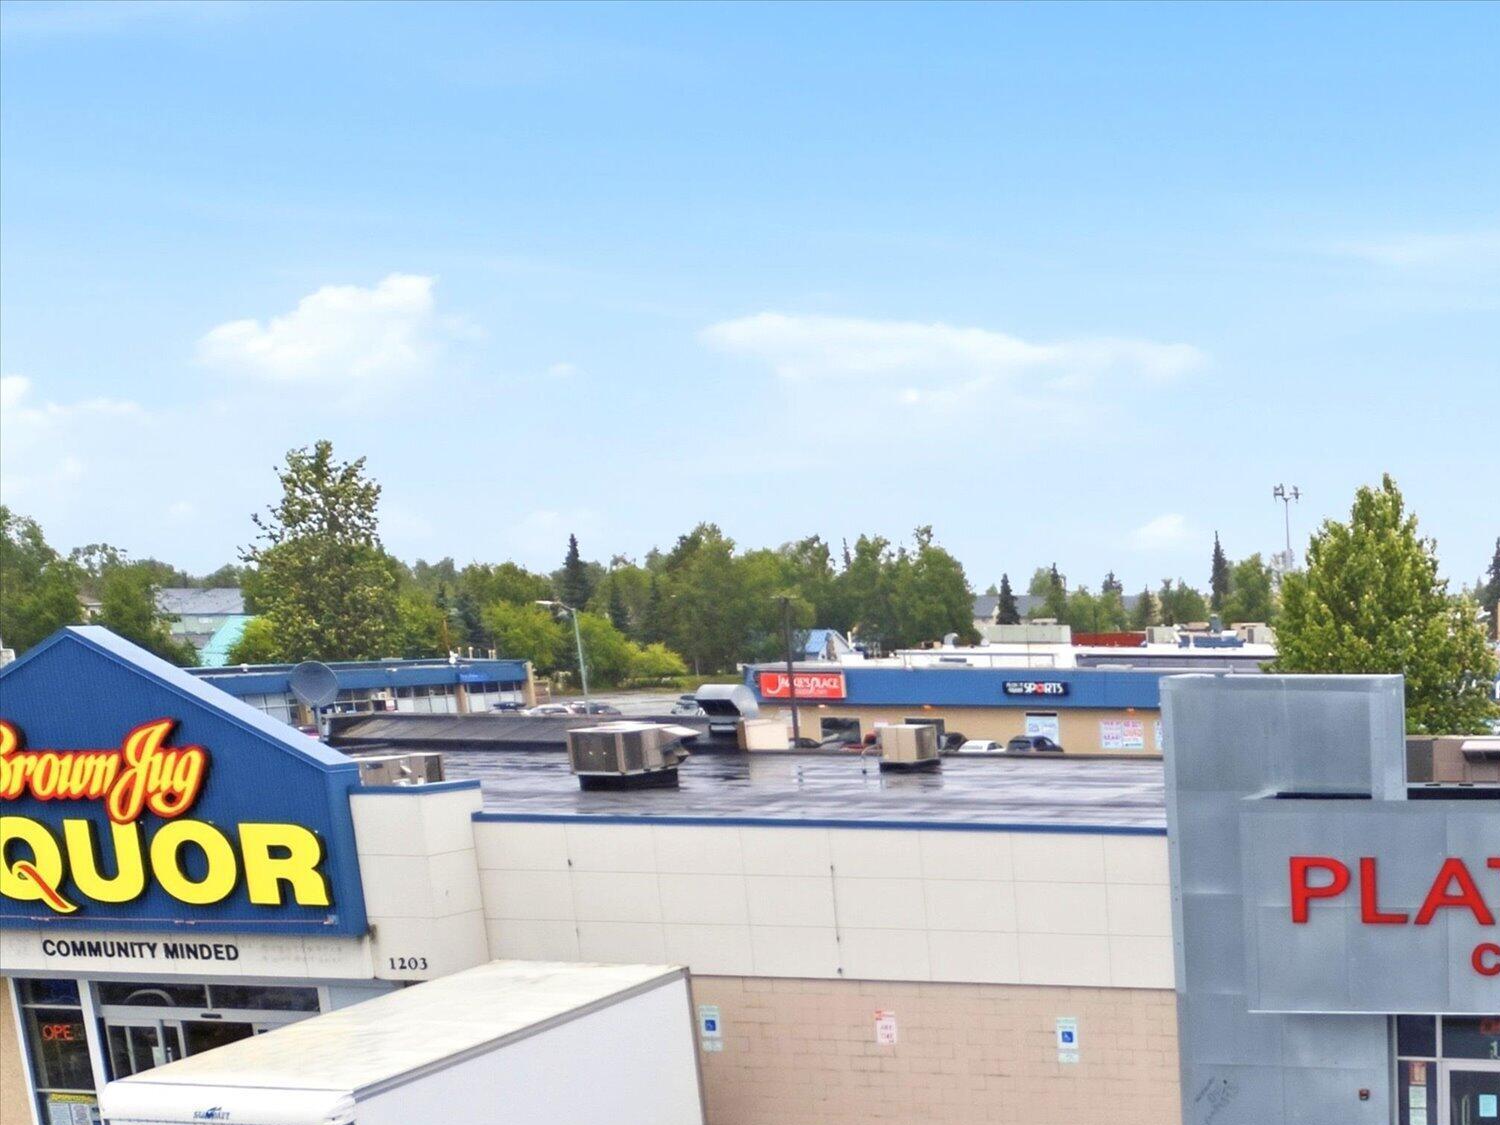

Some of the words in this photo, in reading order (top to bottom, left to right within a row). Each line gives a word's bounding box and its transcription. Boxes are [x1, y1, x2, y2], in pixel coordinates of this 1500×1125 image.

[1024, 682, 1064, 694] SPORTS
[105, 717, 206, 825] Jug
[42, 939, 158, 959] COMMUNITY
[163, 942, 239, 961] MINDED
[389, 956, 428, 970] 1203
